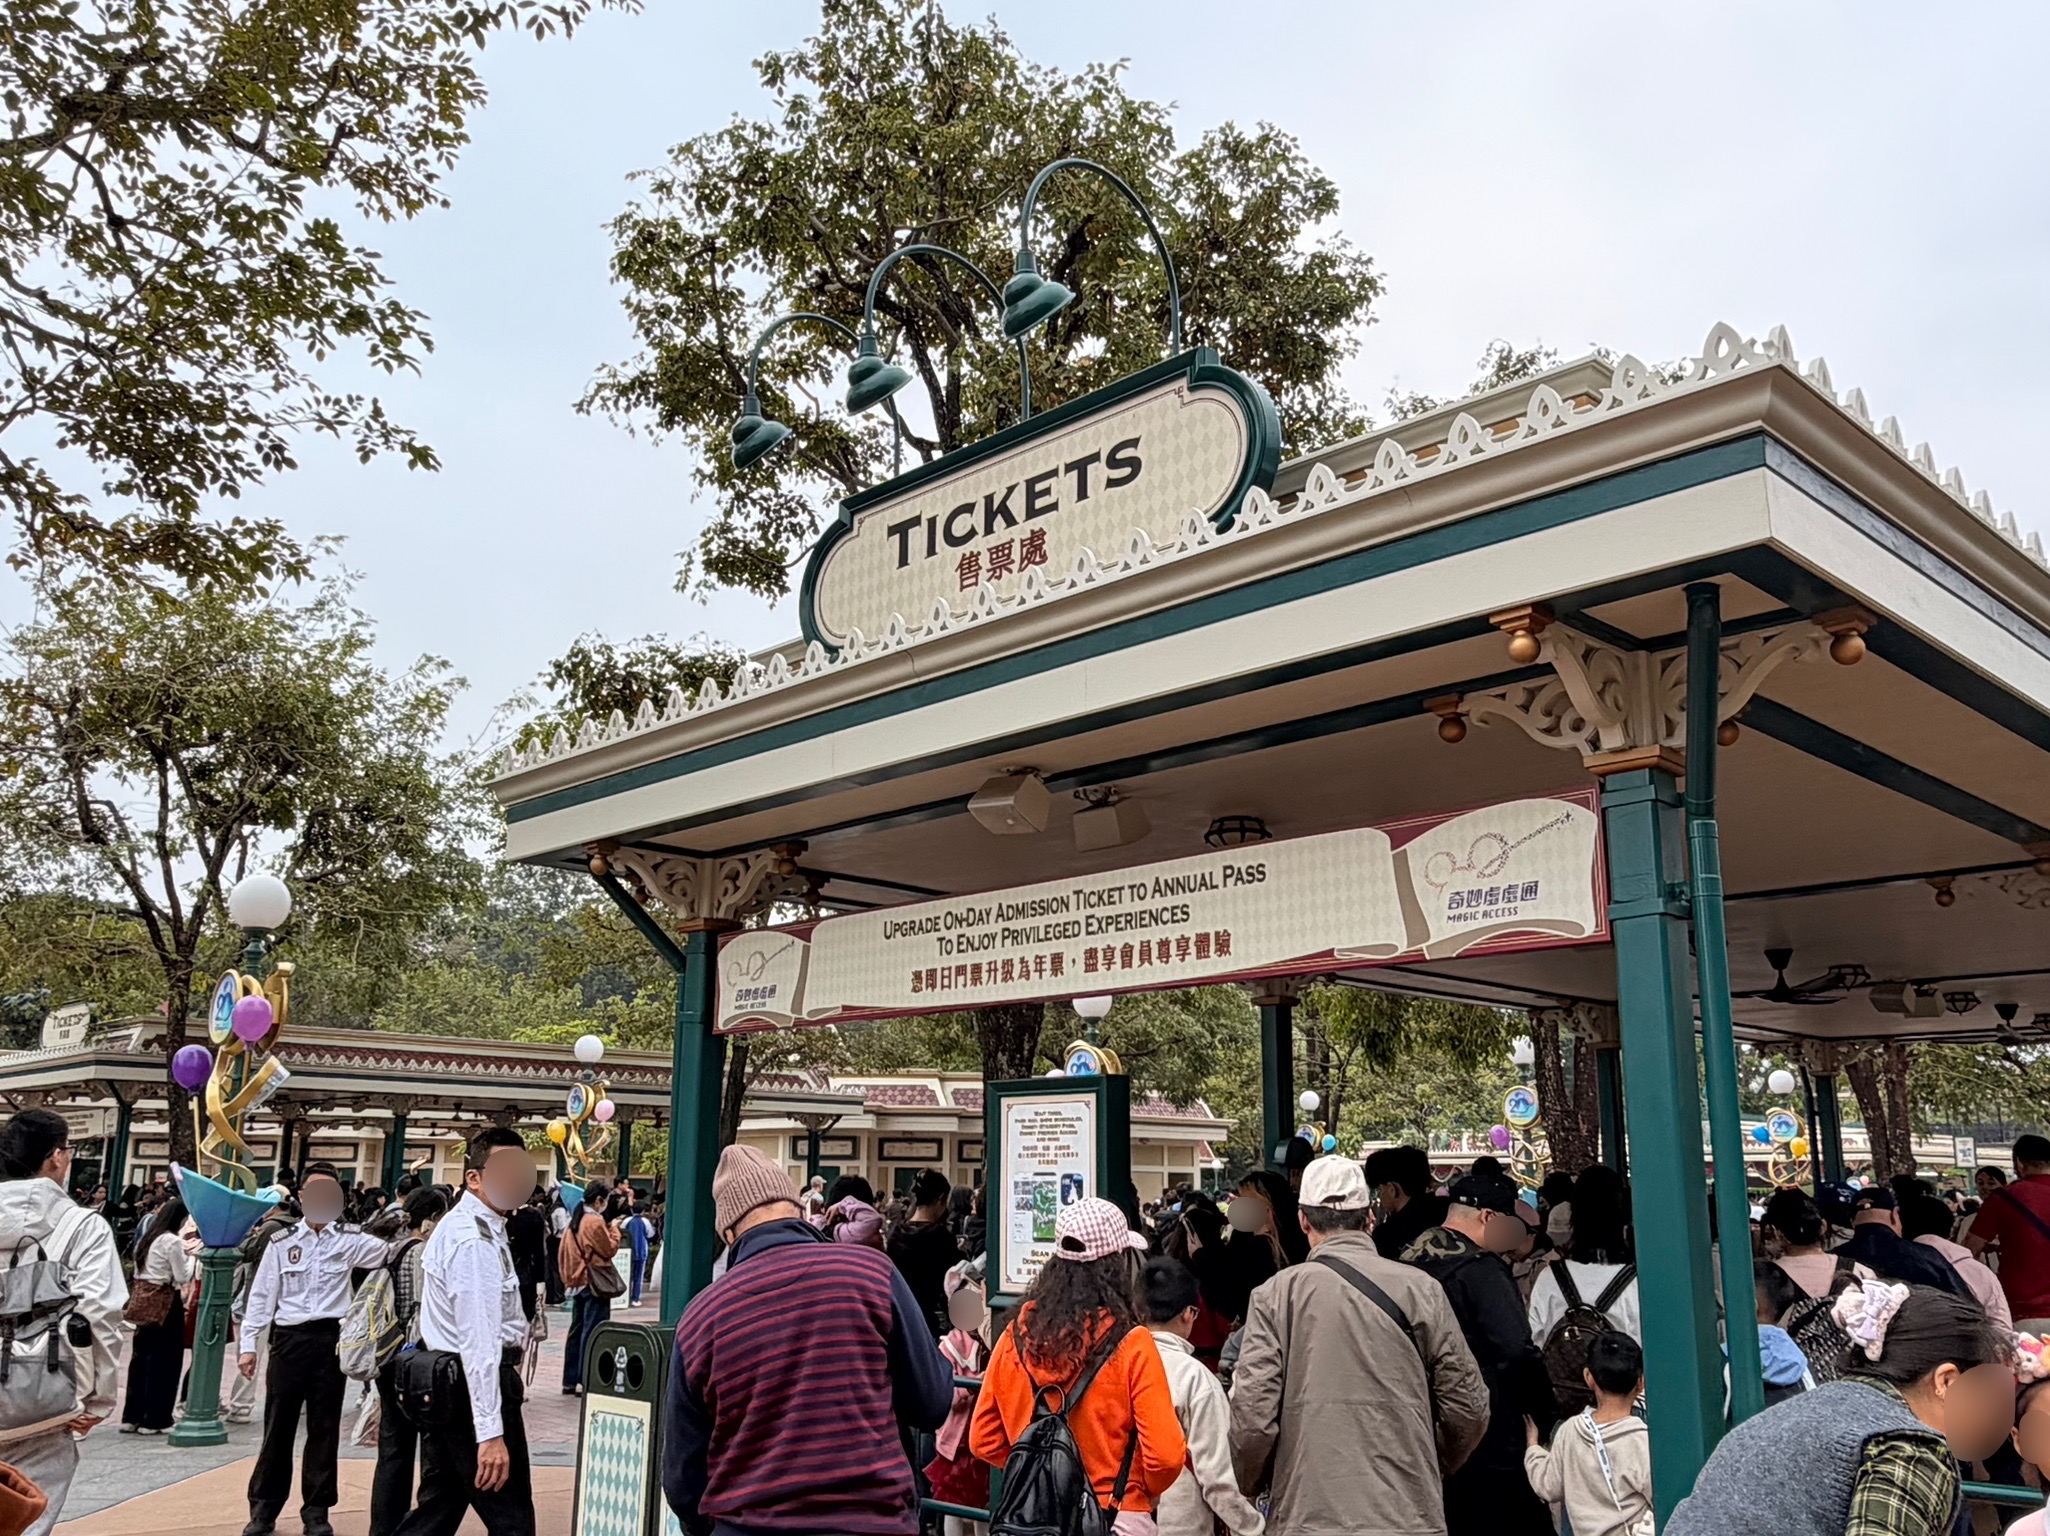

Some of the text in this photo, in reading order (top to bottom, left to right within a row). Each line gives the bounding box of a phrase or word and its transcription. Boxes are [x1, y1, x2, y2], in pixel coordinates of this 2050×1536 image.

[887, 435, 1142, 570] TICKETS
[955, 527, 1048, 592] 售票處
[883, 863, 1266, 940] UPGRADE ON-DAY ADMISSION TICKET TO ANNUAL PASS
[936, 903, 1190, 957] TO ENJOY PRIVILEGED EXPERIENCES
[1446, 906, 1518, 923] MAGIC ACCESS
